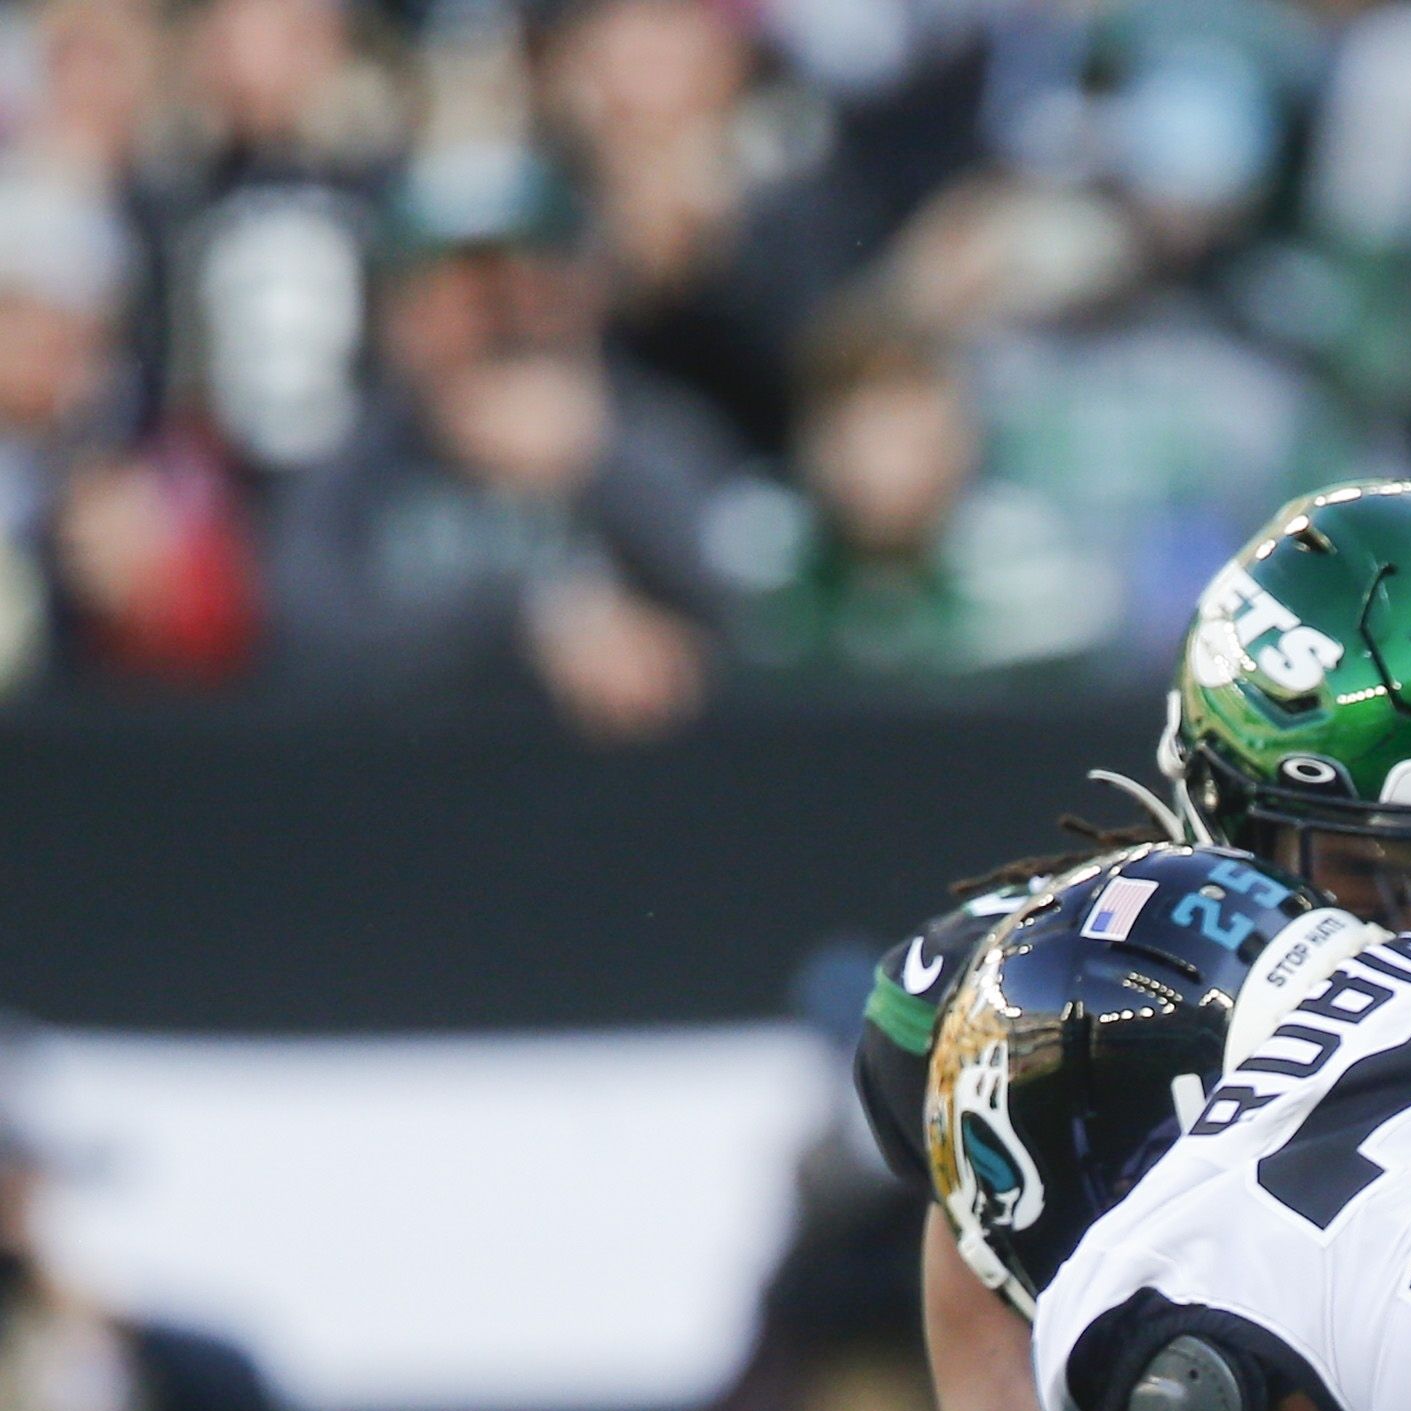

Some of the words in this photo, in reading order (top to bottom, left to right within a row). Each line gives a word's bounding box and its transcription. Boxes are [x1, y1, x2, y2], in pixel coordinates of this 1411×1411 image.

[1200, 560, 1344, 692] ETS
[1171, 859, 1293, 951] 25
[1267, 943, 1309, 987] STOP
